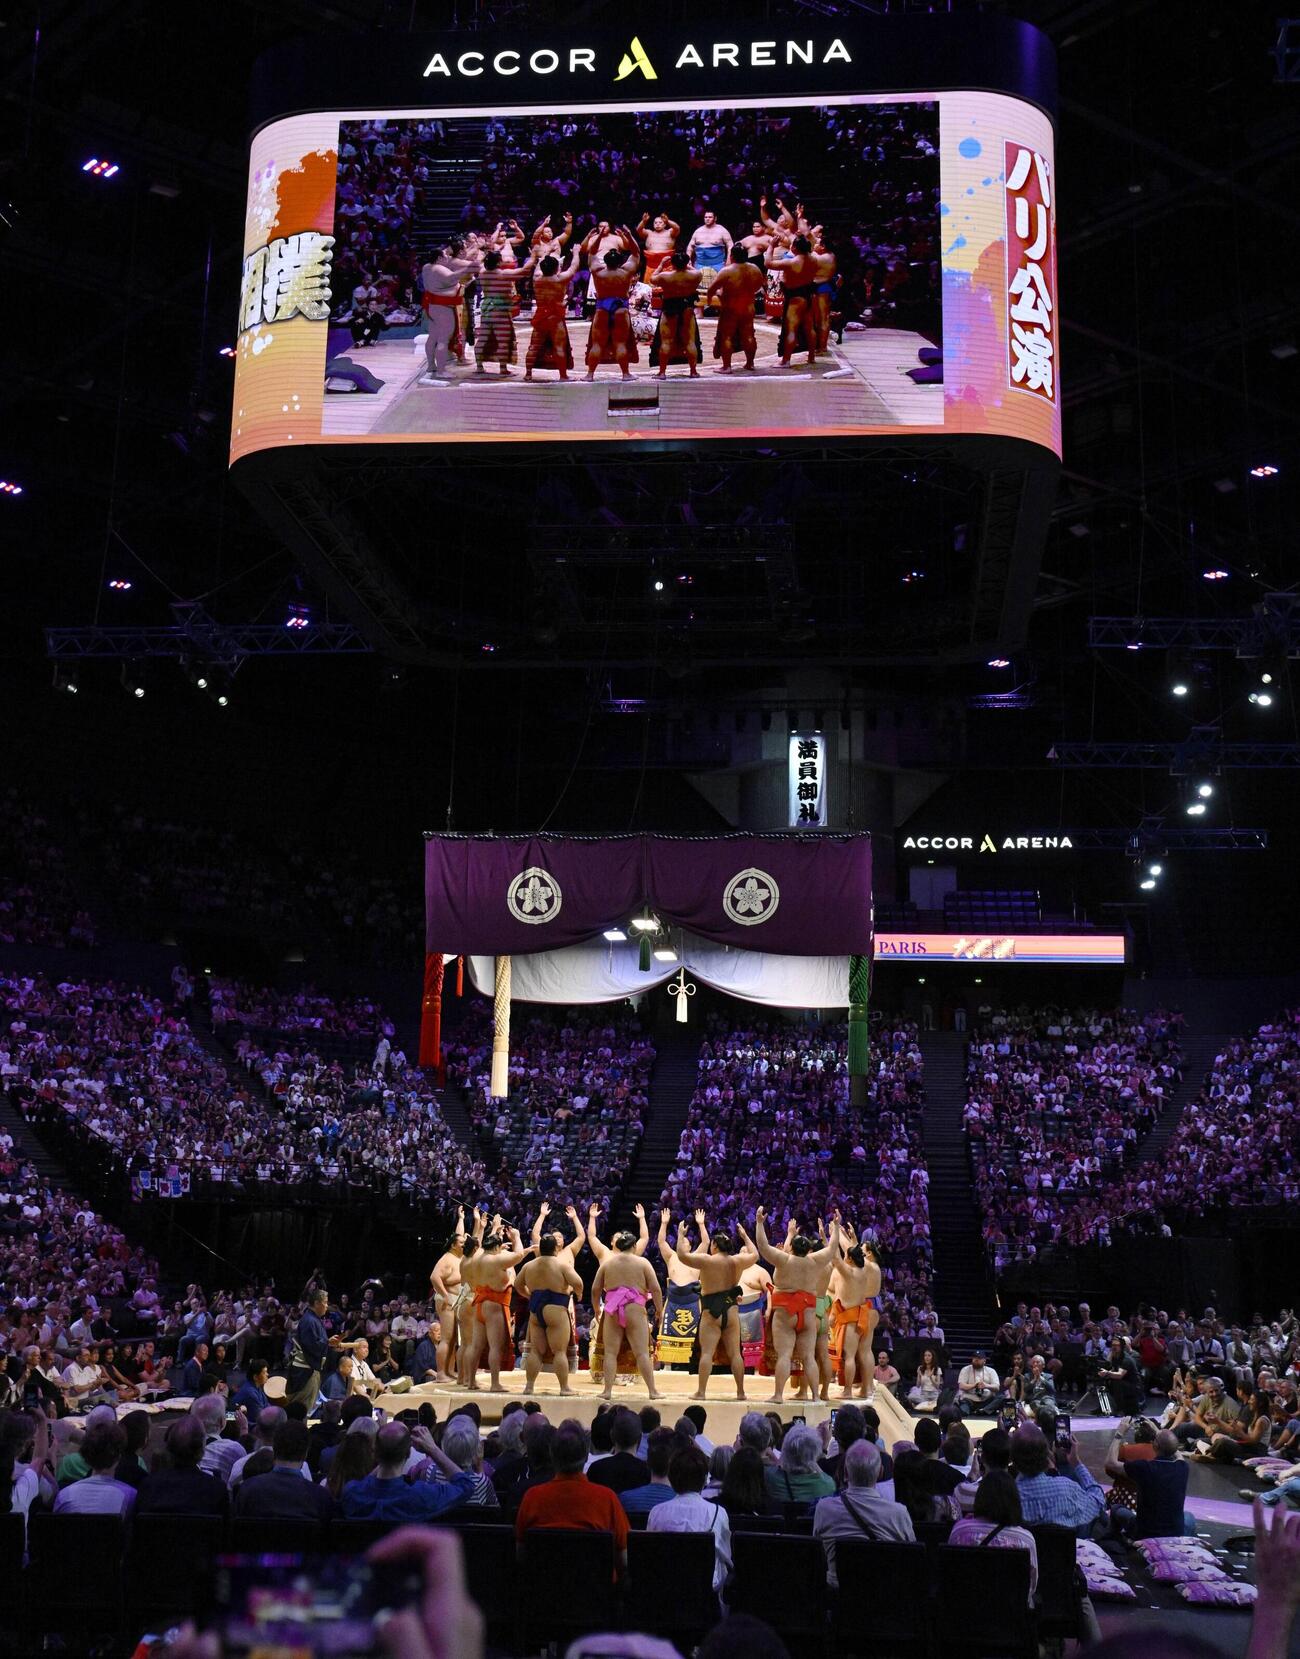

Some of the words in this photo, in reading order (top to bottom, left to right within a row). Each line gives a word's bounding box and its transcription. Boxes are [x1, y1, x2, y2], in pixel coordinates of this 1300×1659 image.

[422, 48, 596, 78] ACCOR
[675, 38, 852, 69] ARENA
[1005, 148, 1054, 398] パリ公演
[797, 740, 820, 821] 満員御礼
[903, 836, 974, 850] ACCOR
[1002, 836, 1073, 849] ARENA
[878, 941, 927, 955] PARIS
